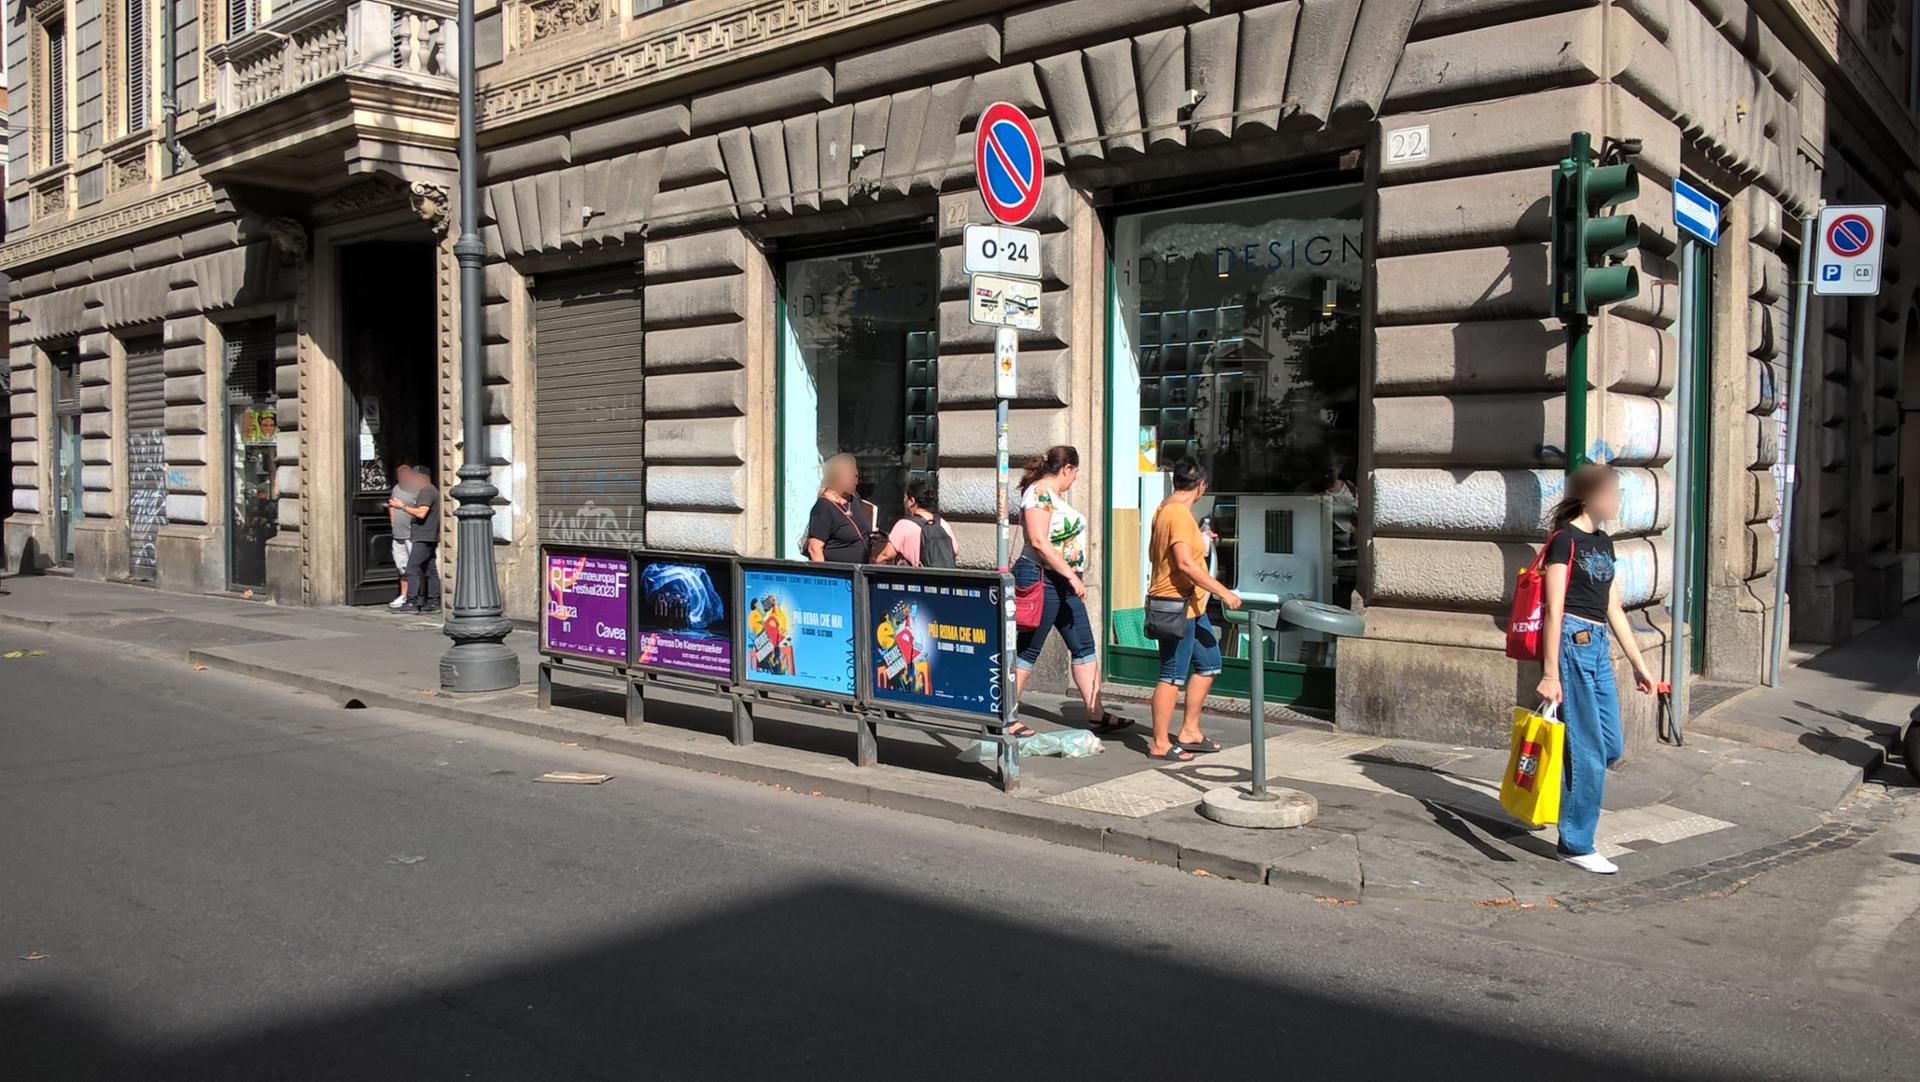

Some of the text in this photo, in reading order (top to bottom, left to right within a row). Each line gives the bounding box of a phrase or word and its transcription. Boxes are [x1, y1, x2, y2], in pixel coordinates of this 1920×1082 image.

[1826, 266, 1838, 280] P
[551, 601, 577, 618] Danza
[803, 611, 819, 626] ROMA
[820, 613, 831, 627] CHE
[831, 614, 843, 628] MAI
[596, 621, 627, 641] Cavea
[939, 623, 958, 641] ROMA
[959, 625, 971, 642] CHE
[972, 627, 986, 644] MAI
[675, 638, 683, 649] De
[988, 652, 1003, 713] ROMA
[1519, 755, 1538, 775] EGO
